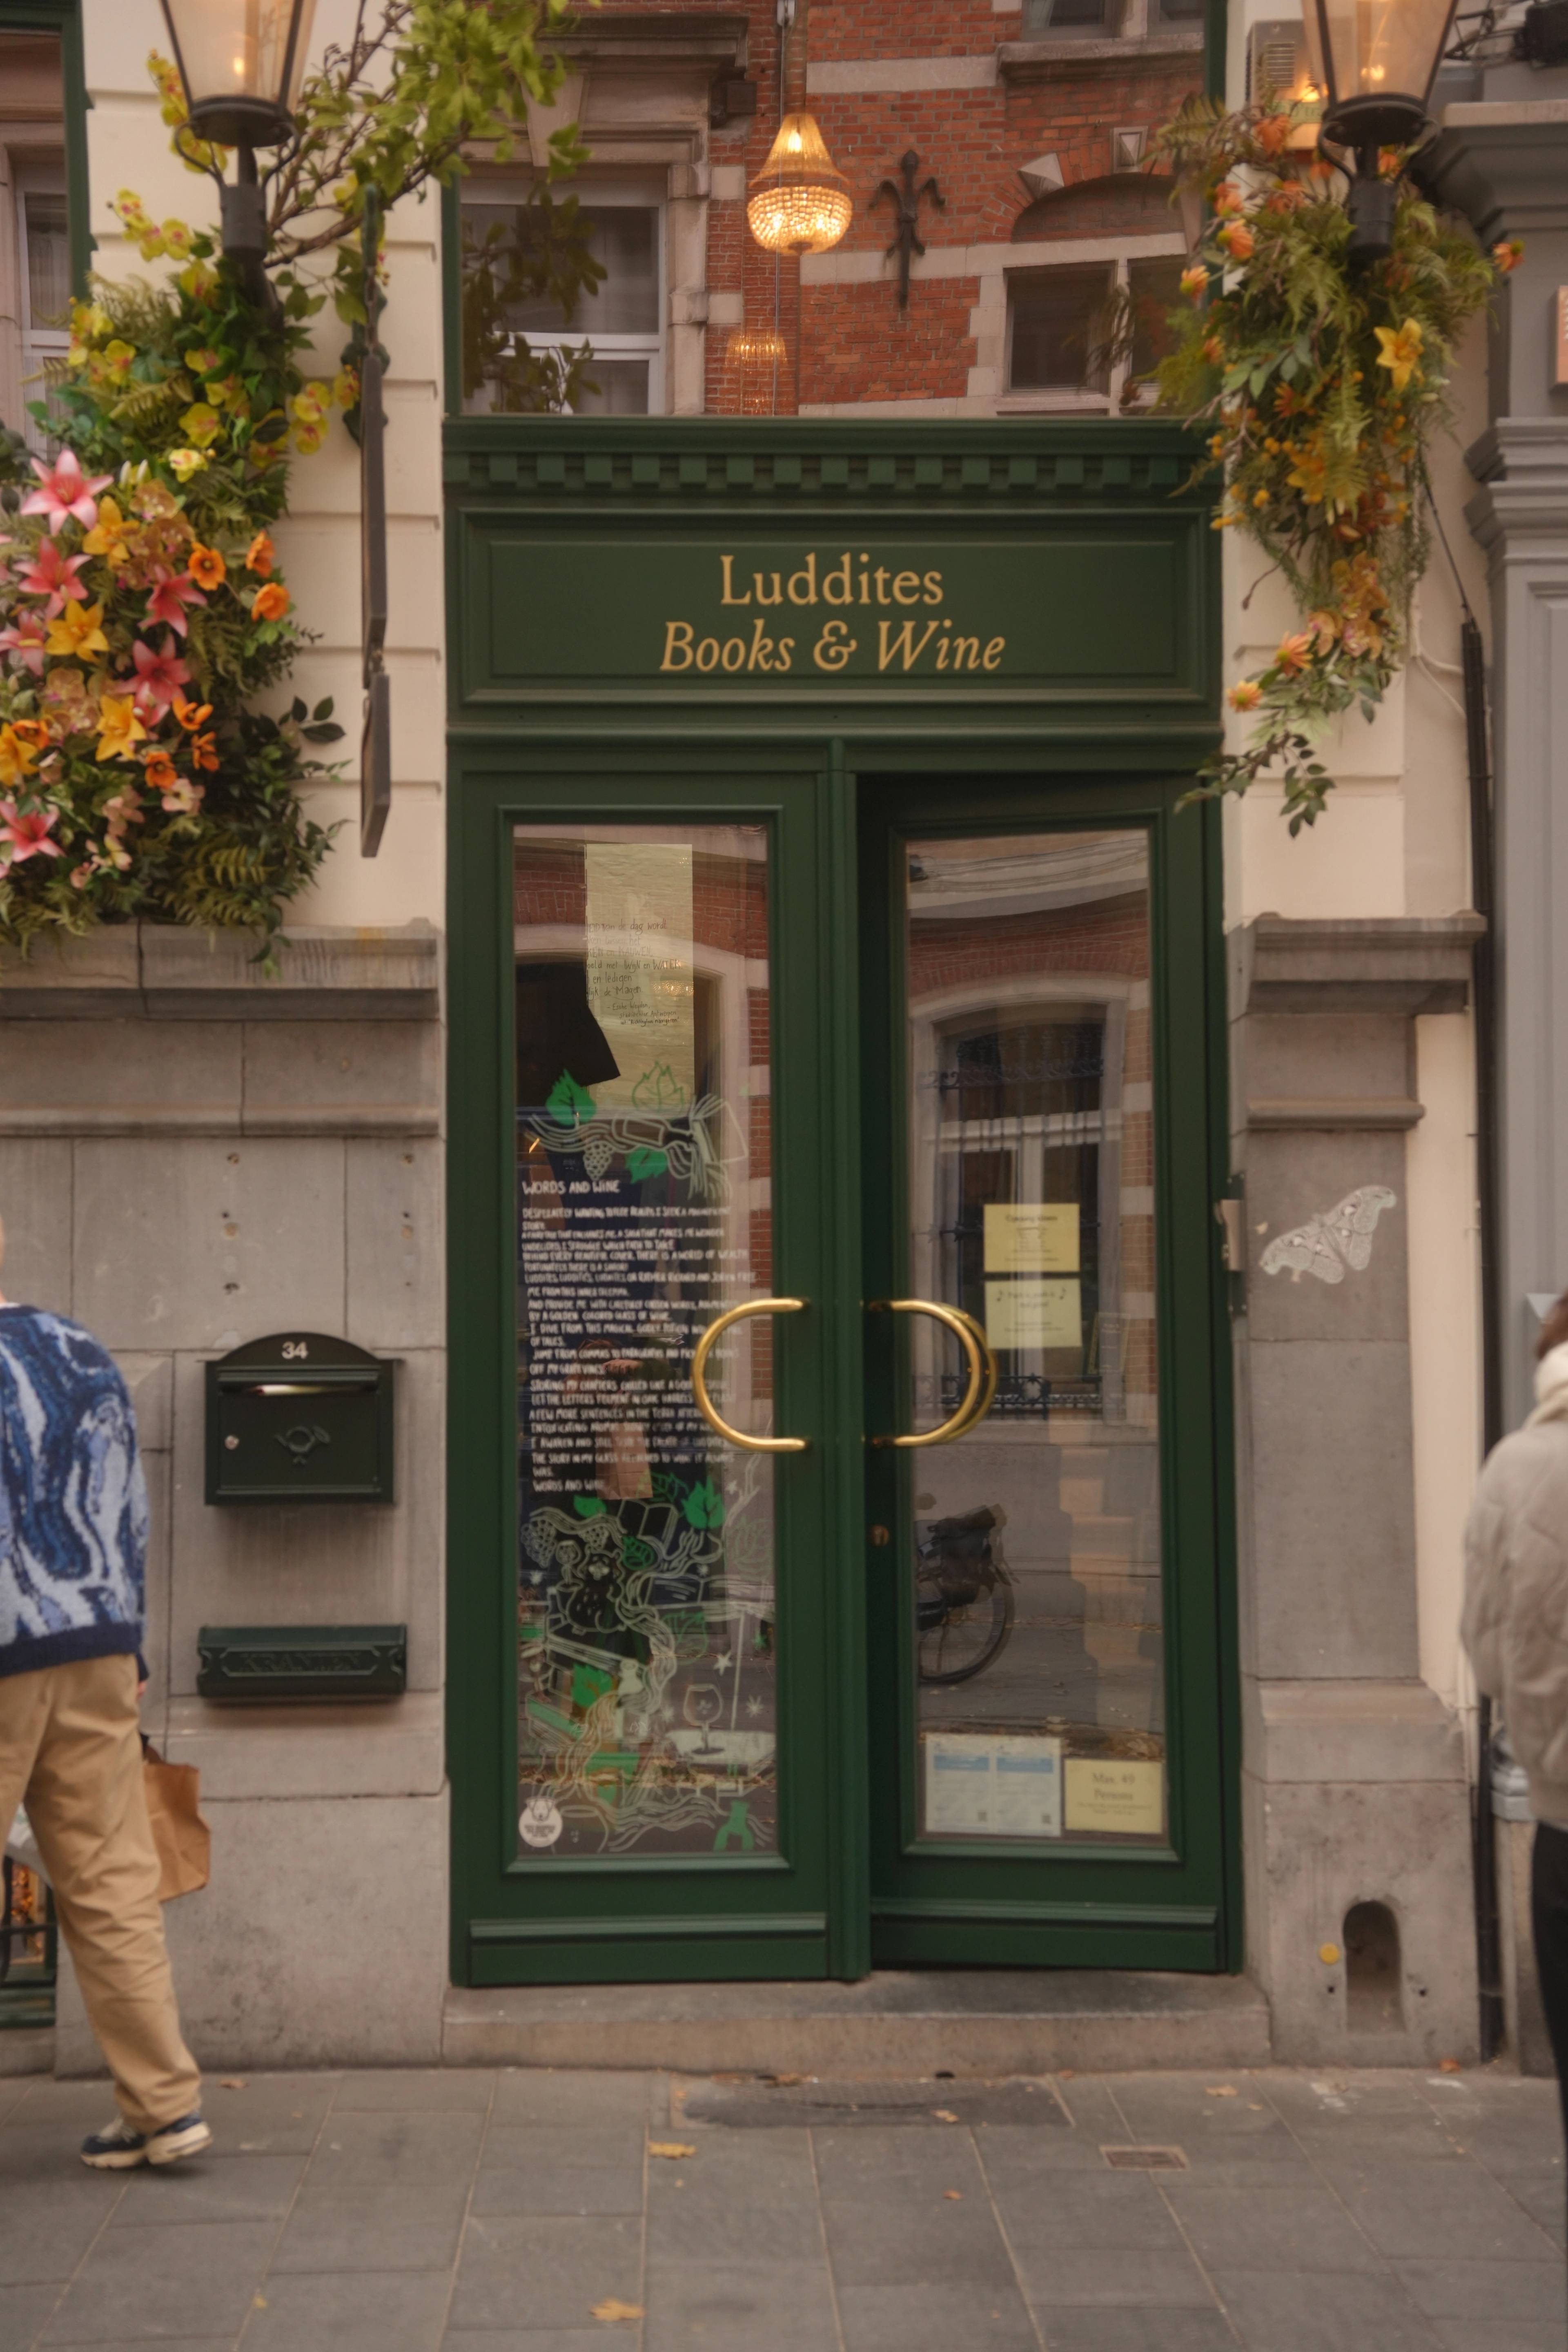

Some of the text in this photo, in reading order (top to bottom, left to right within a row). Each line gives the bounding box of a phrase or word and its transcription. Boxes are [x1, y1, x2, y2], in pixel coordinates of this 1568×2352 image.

[720, 552, 943, 605] Luddites
[659, 619, 1006, 671] Books & Wine
[618, 918, 626, 930] de
[630, 918, 644, 935] dag
[647, 918, 667, 930] wordt
[629, 933, 641, 945] het
[607, 960, 617, 969] met
[605, 971, 632, 988] ledigen
[604, 987, 611, 996] de
[650, 1010, 677, 1018] Antwerpen
[522, 1180, 566, 1195] WORDS
[569, 1180, 591, 1194] AND
[281, 1341, 309, 1360] 34
[536, 1409, 554, 1421] FEW
[555, 1408, 577, 1421] MORE
[532, 1479, 563, 1492] WORDS
[564, 1479, 583, 1491] AND
